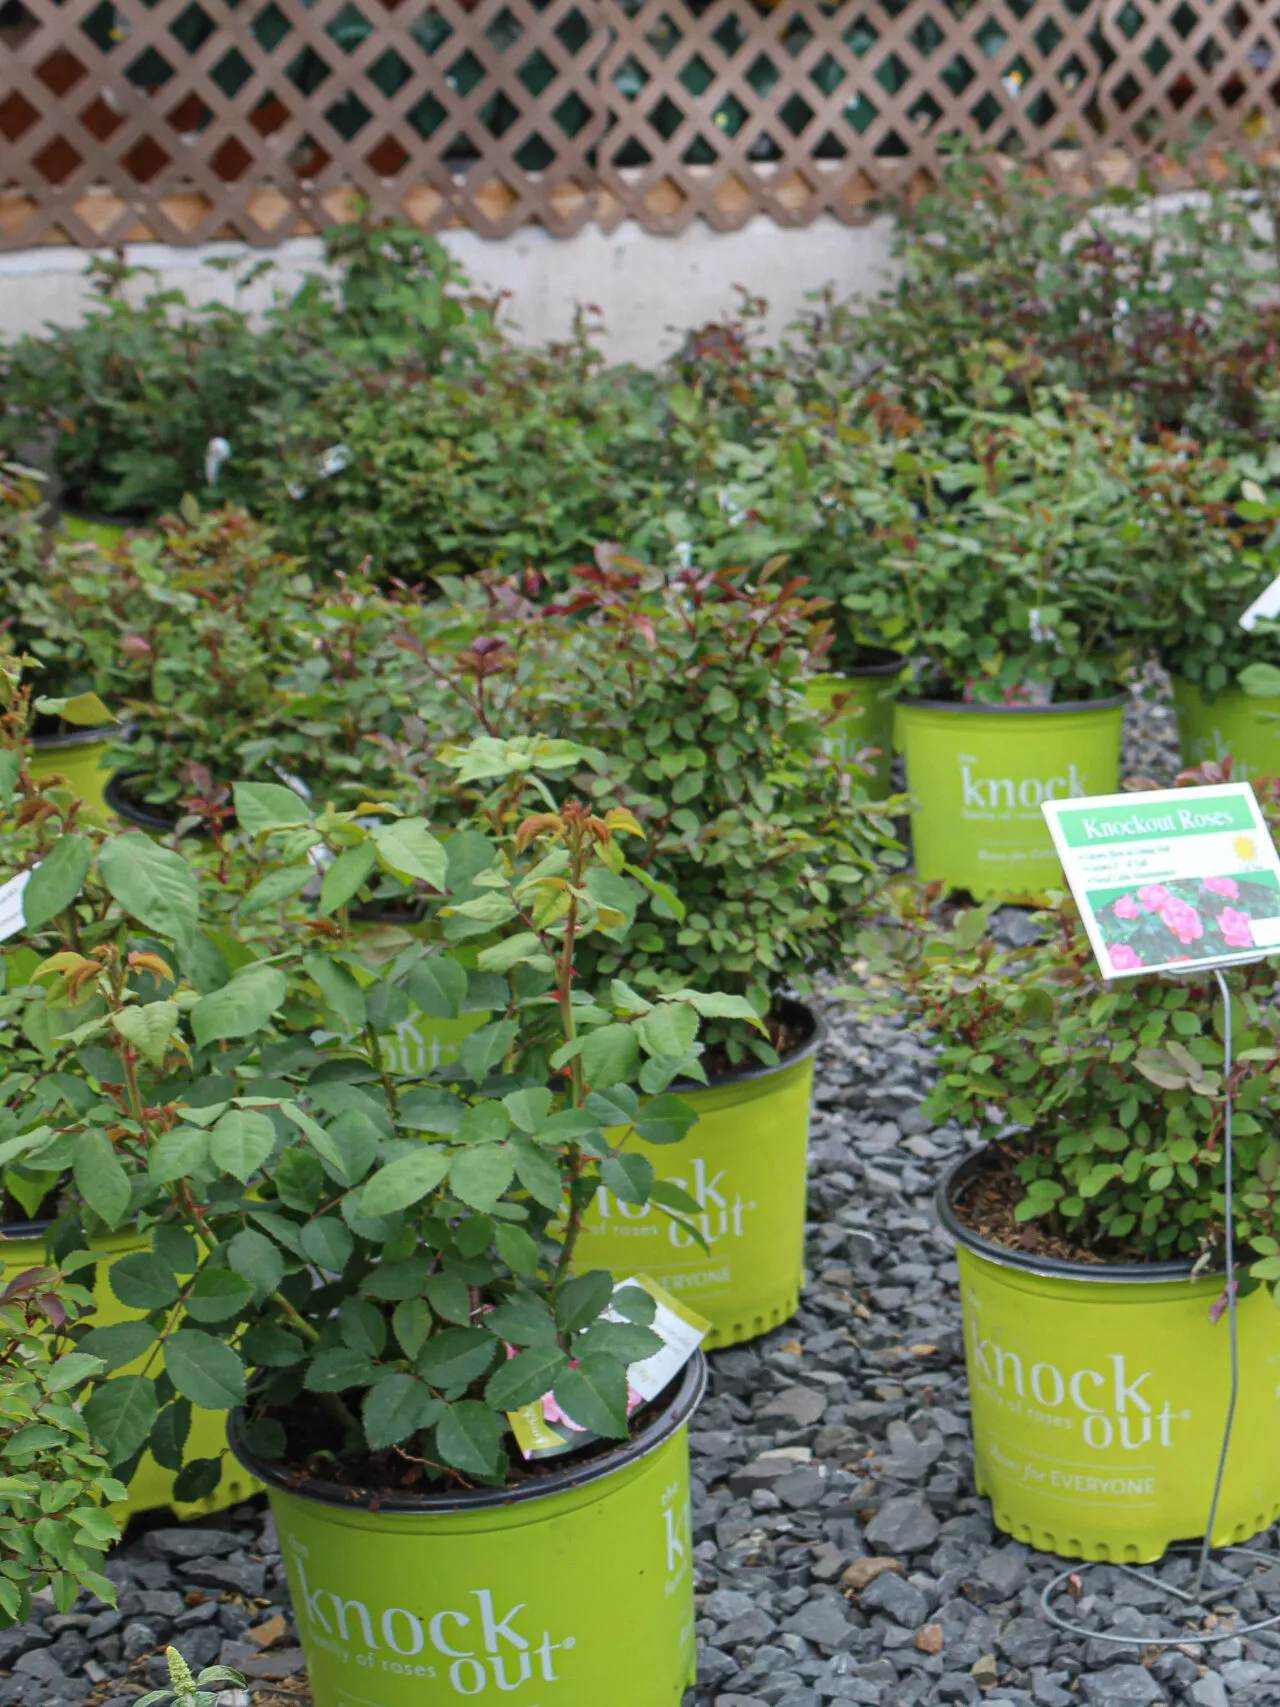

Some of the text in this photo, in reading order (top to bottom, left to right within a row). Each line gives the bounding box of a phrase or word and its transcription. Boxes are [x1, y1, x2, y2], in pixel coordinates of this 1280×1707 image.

[962, 764, 1087, 808] knock
[1083, 809, 1234, 839] Knockout Roses
[970, 1309, 1154, 1413] knock
[1082, 1401, 1181, 1450] out
[1051, 1470, 1156, 1495] EVERYONE
[294, 1555, 530, 1657] knock
[356, 1651, 437, 1678] of roses
[449, 1632, 562, 1695] out
